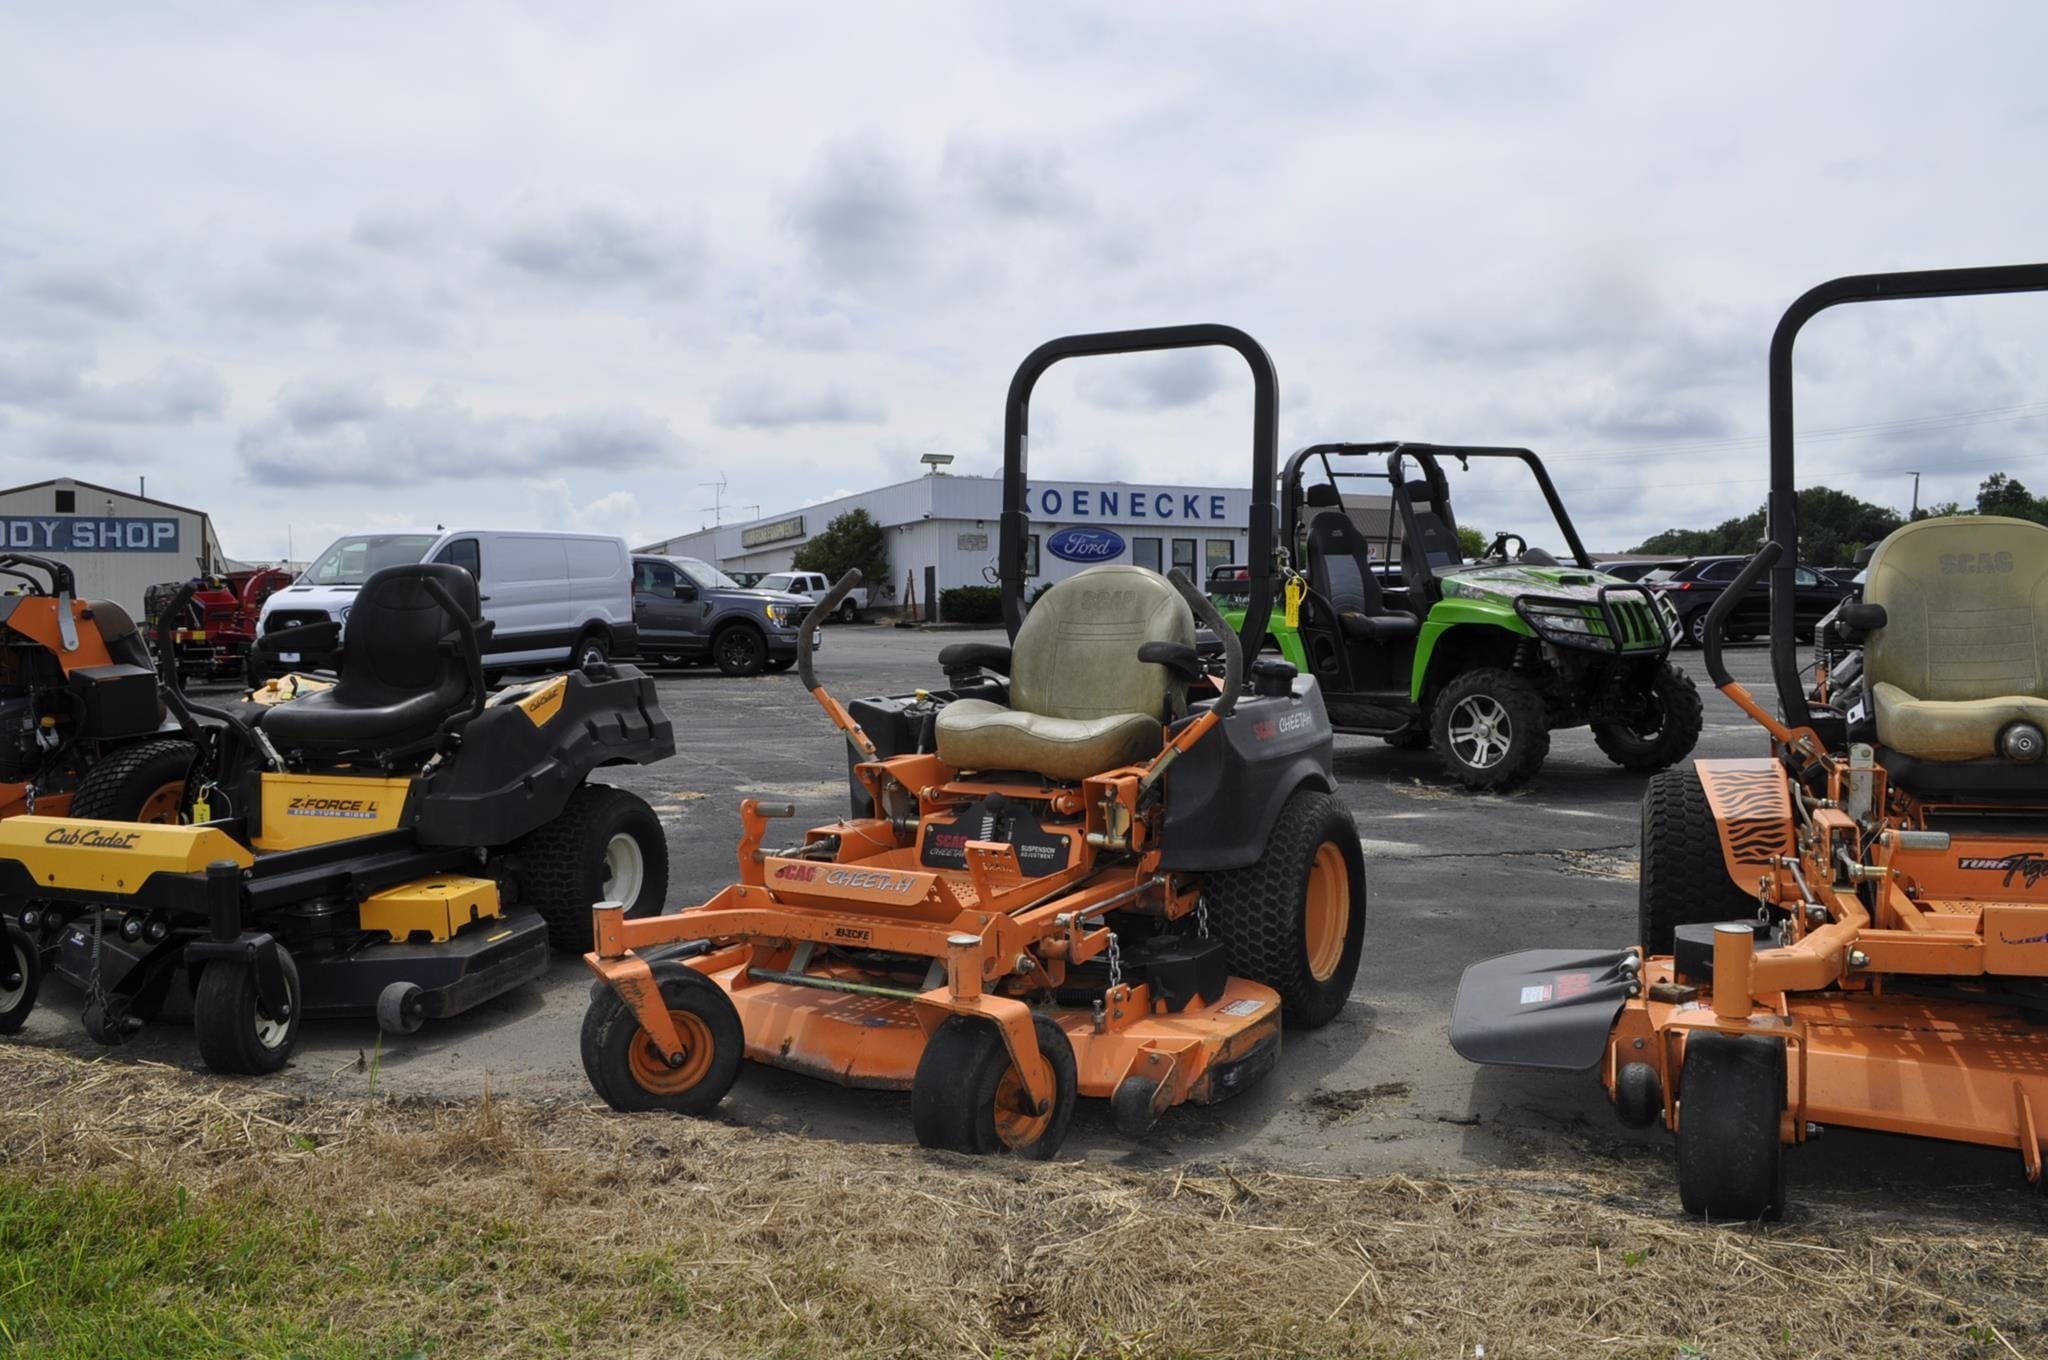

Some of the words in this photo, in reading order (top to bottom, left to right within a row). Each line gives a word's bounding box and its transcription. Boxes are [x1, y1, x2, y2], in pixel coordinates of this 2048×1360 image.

[0, 521, 60, 547] DY
[72, 522, 175, 548] SHOP
[1064, 532, 1109, 555] Ford
[368, 801, 378, 812] L
[44, 827, 80, 846] Cub
[79, 829, 142, 849] Cadet
[1020, 844, 1056, 854] SUSPENSION
[1020, 851, 1055, 860] ADJUSTMENT
[1960, 859, 2011, 869] TURF
